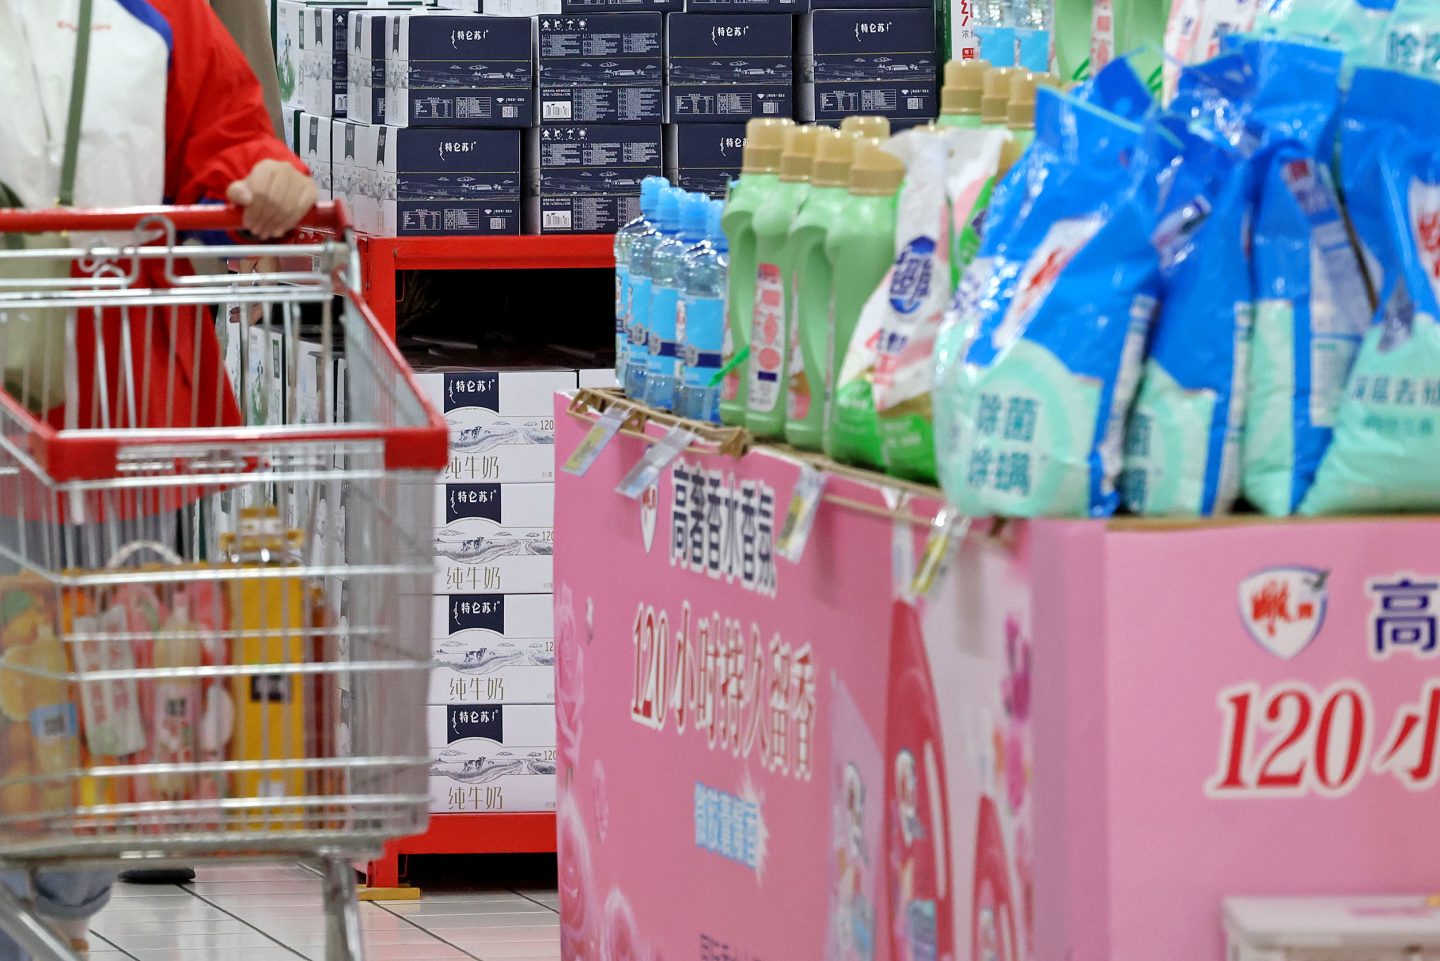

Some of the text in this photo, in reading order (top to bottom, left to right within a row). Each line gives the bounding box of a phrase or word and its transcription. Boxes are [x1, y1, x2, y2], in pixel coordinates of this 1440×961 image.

[457, 29, 482, 41] 特仑苏
[717, 26, 742, 38] 特仑苏
[860, 22, 885, 34] 特仑苏
[444, 141, 470, 153] 特仑苏
[455, 379, 487, 394] 特仑苏
[445, 455, 500, 480] 纯牛奶
[457, 490, 488, 504] 特仑苏
[445, 565, 501, 591] 纯牛奶
[460, 601, 493, 615] 特仑苏
[1372, 579, 1439, 653] 高
[449, 676, 504, 702] 纯牛奶
[459, 710, 490, 724] 特仑苏
[448, 786, 503, 811] 纯牛奶
